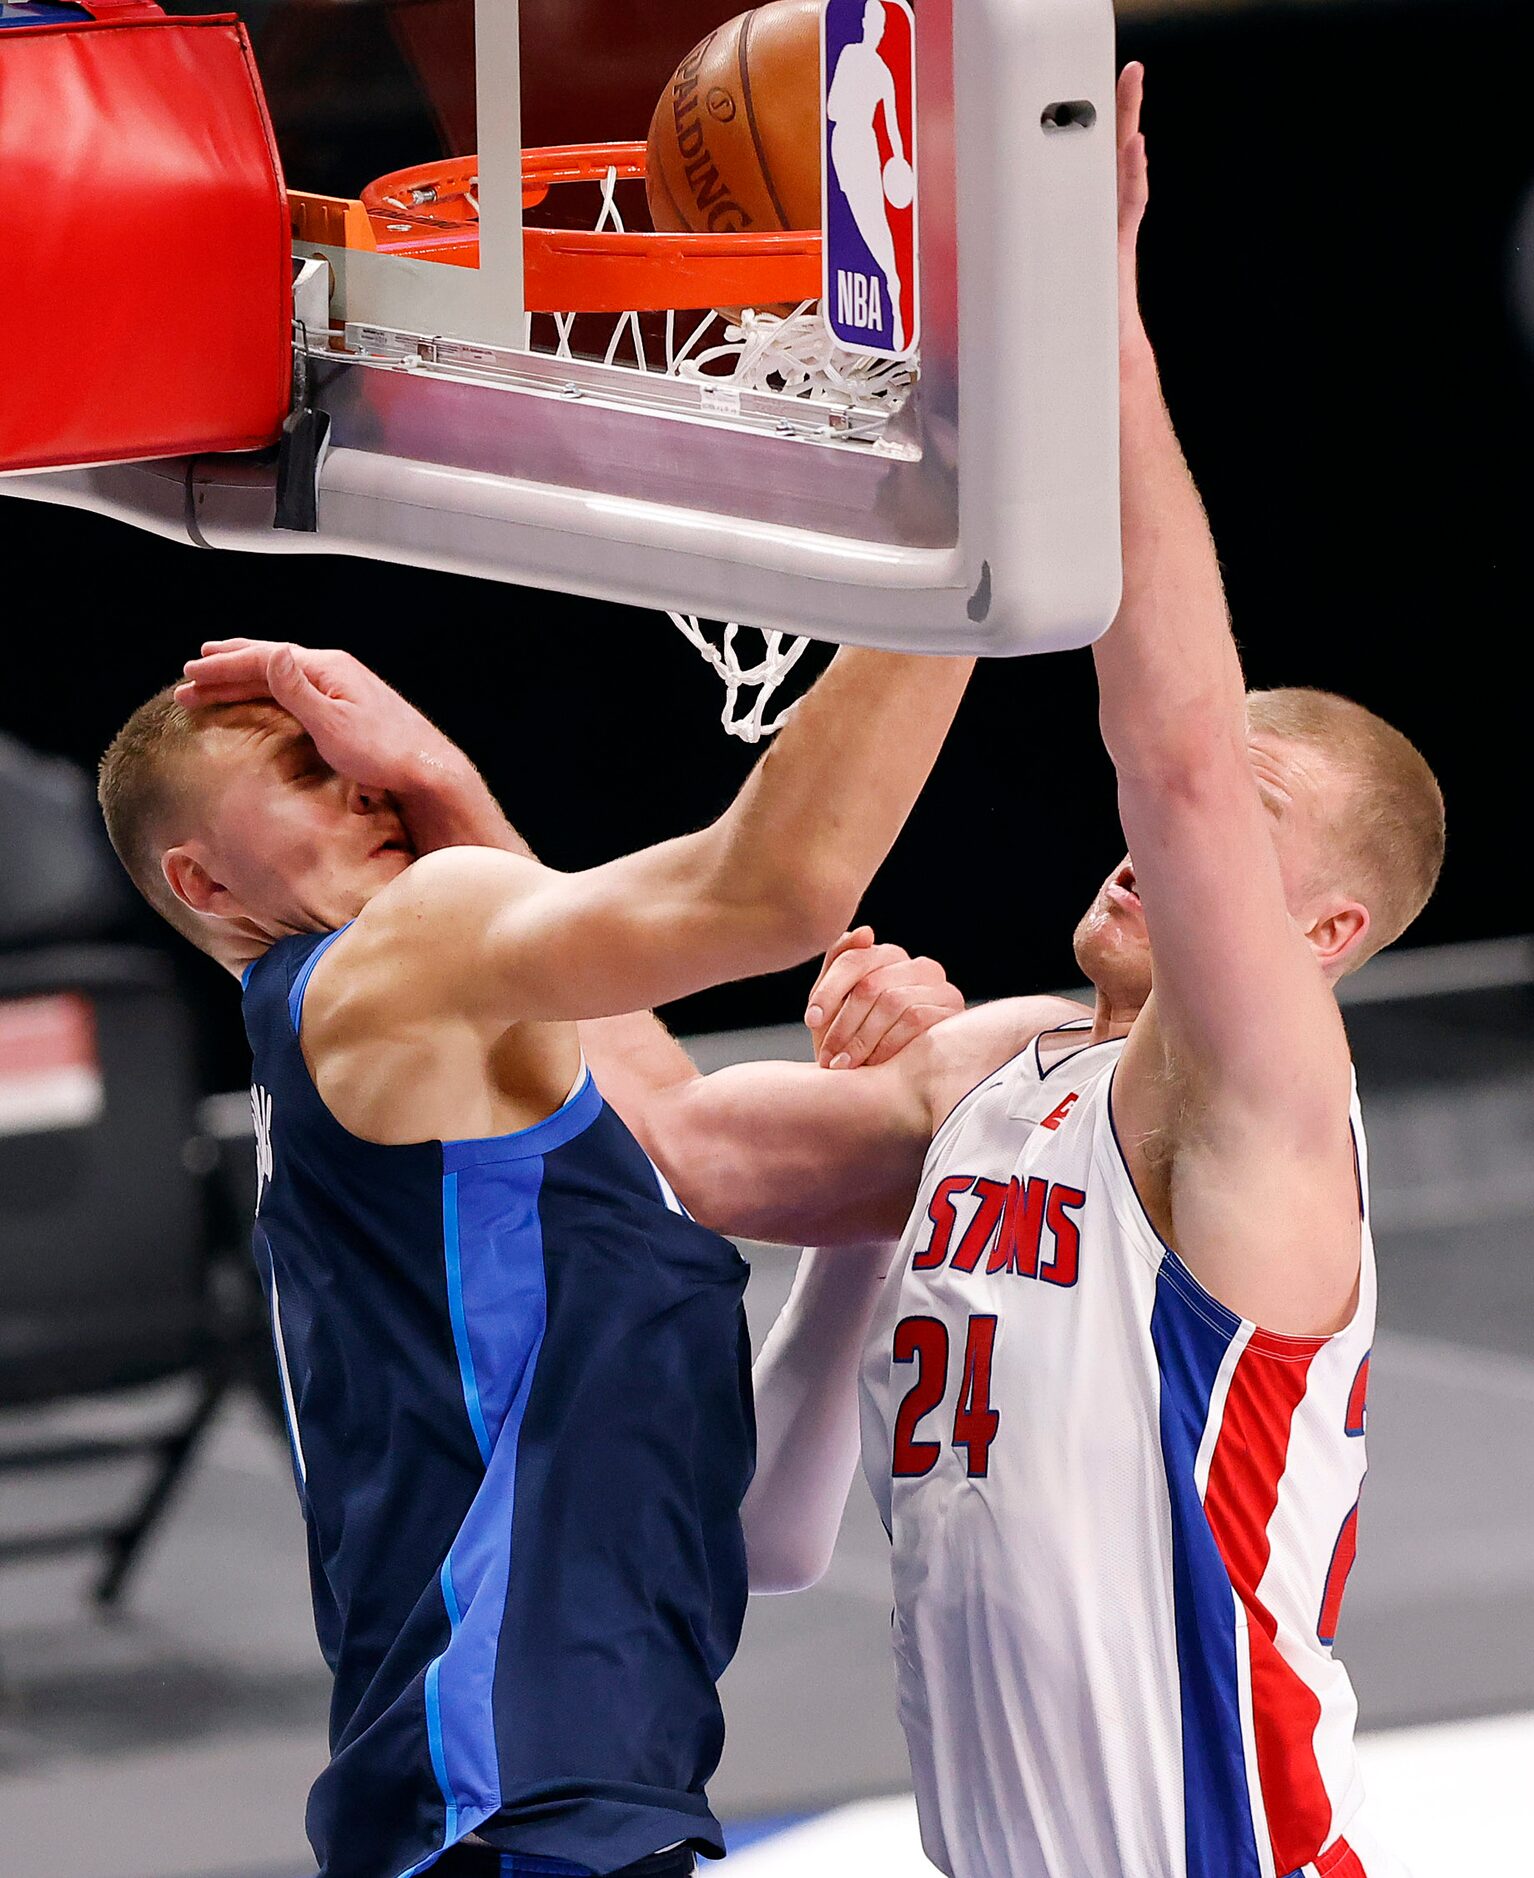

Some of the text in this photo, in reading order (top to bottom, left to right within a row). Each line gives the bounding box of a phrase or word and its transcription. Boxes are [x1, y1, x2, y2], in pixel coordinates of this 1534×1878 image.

[673, 31, 753, 232] PALDING
[837, 269, 883, 332] NBA
[891, 1314, 1000, 1478] 24
